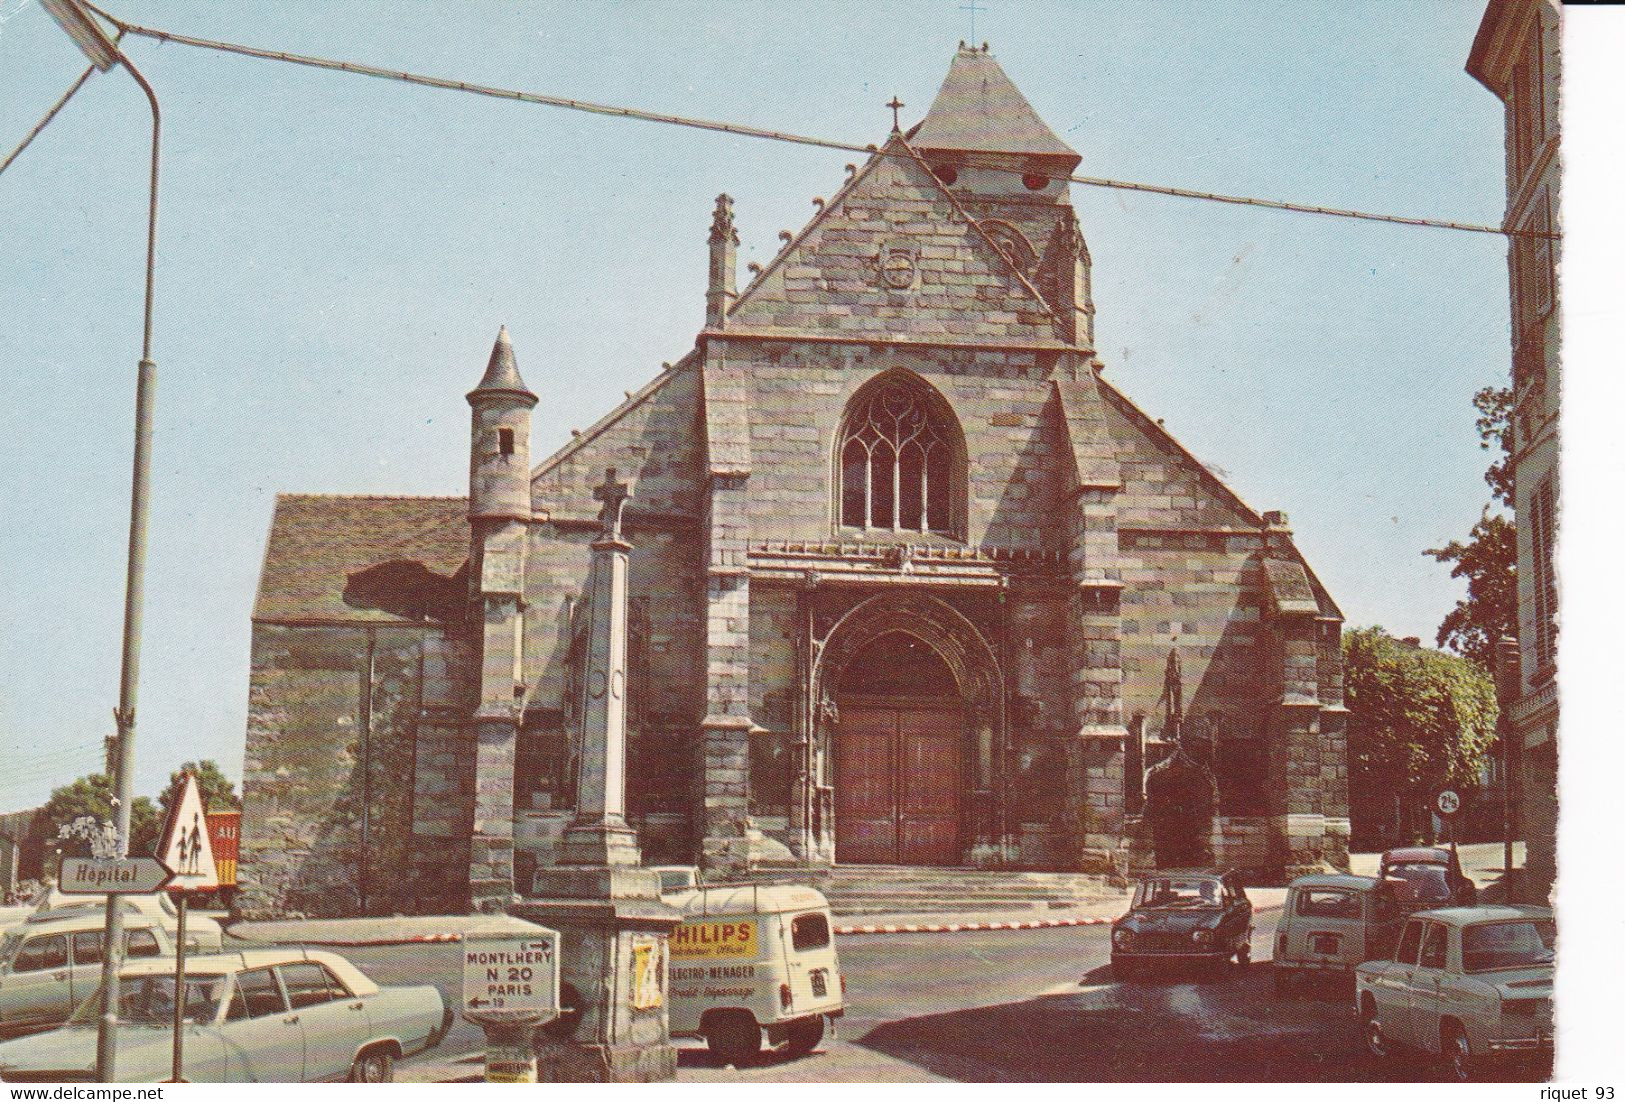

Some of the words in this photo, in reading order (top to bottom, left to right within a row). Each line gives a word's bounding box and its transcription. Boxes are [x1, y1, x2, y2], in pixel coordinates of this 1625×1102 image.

[486, 967, 498, 981] N
[507, 966, 533, 981] 20
[487, 984, 532, 996] PARIS
